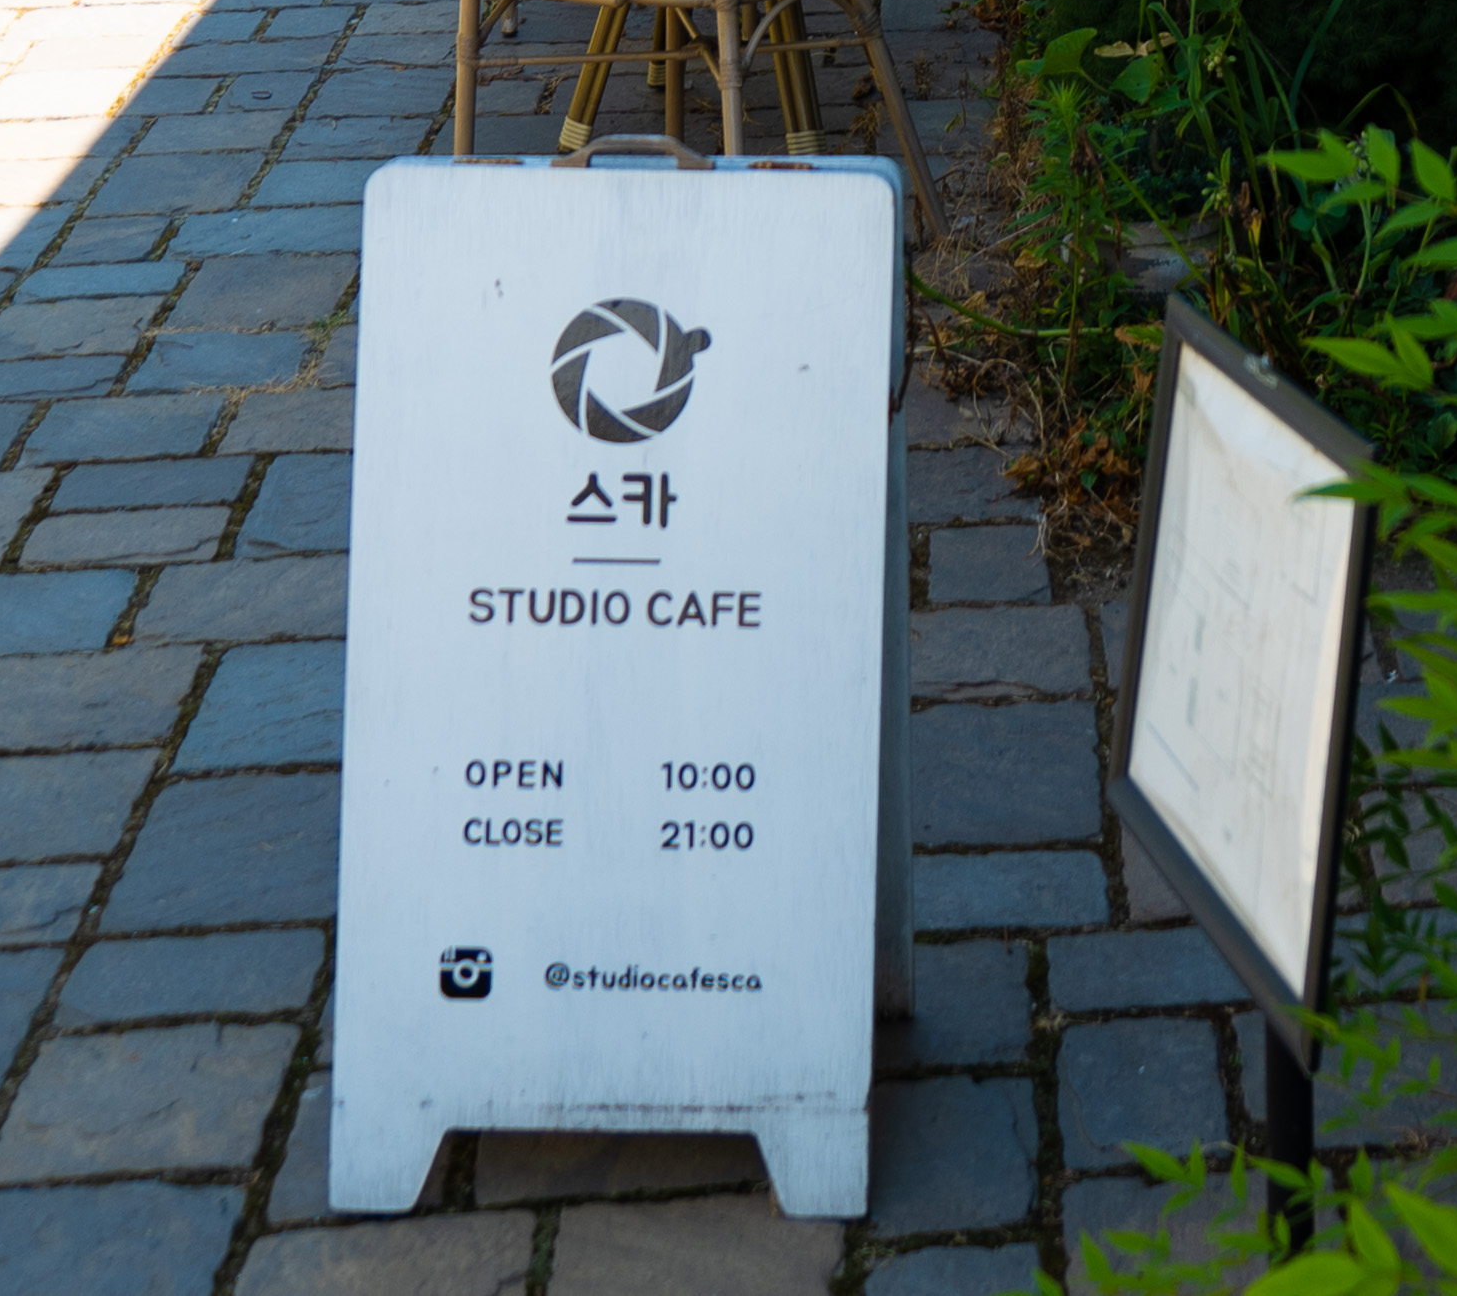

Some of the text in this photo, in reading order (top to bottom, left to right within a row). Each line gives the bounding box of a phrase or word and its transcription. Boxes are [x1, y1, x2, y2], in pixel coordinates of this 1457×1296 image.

[567, 473, 677, 529] 스카
[469, 588, 762, 629] STUDIO CAFE
[465, 760, 756, 792] OPEN 10:00
[463, 818, 755, 851] CLOSE 21:00
[544, 961, 763, 993] @studiocafesca
